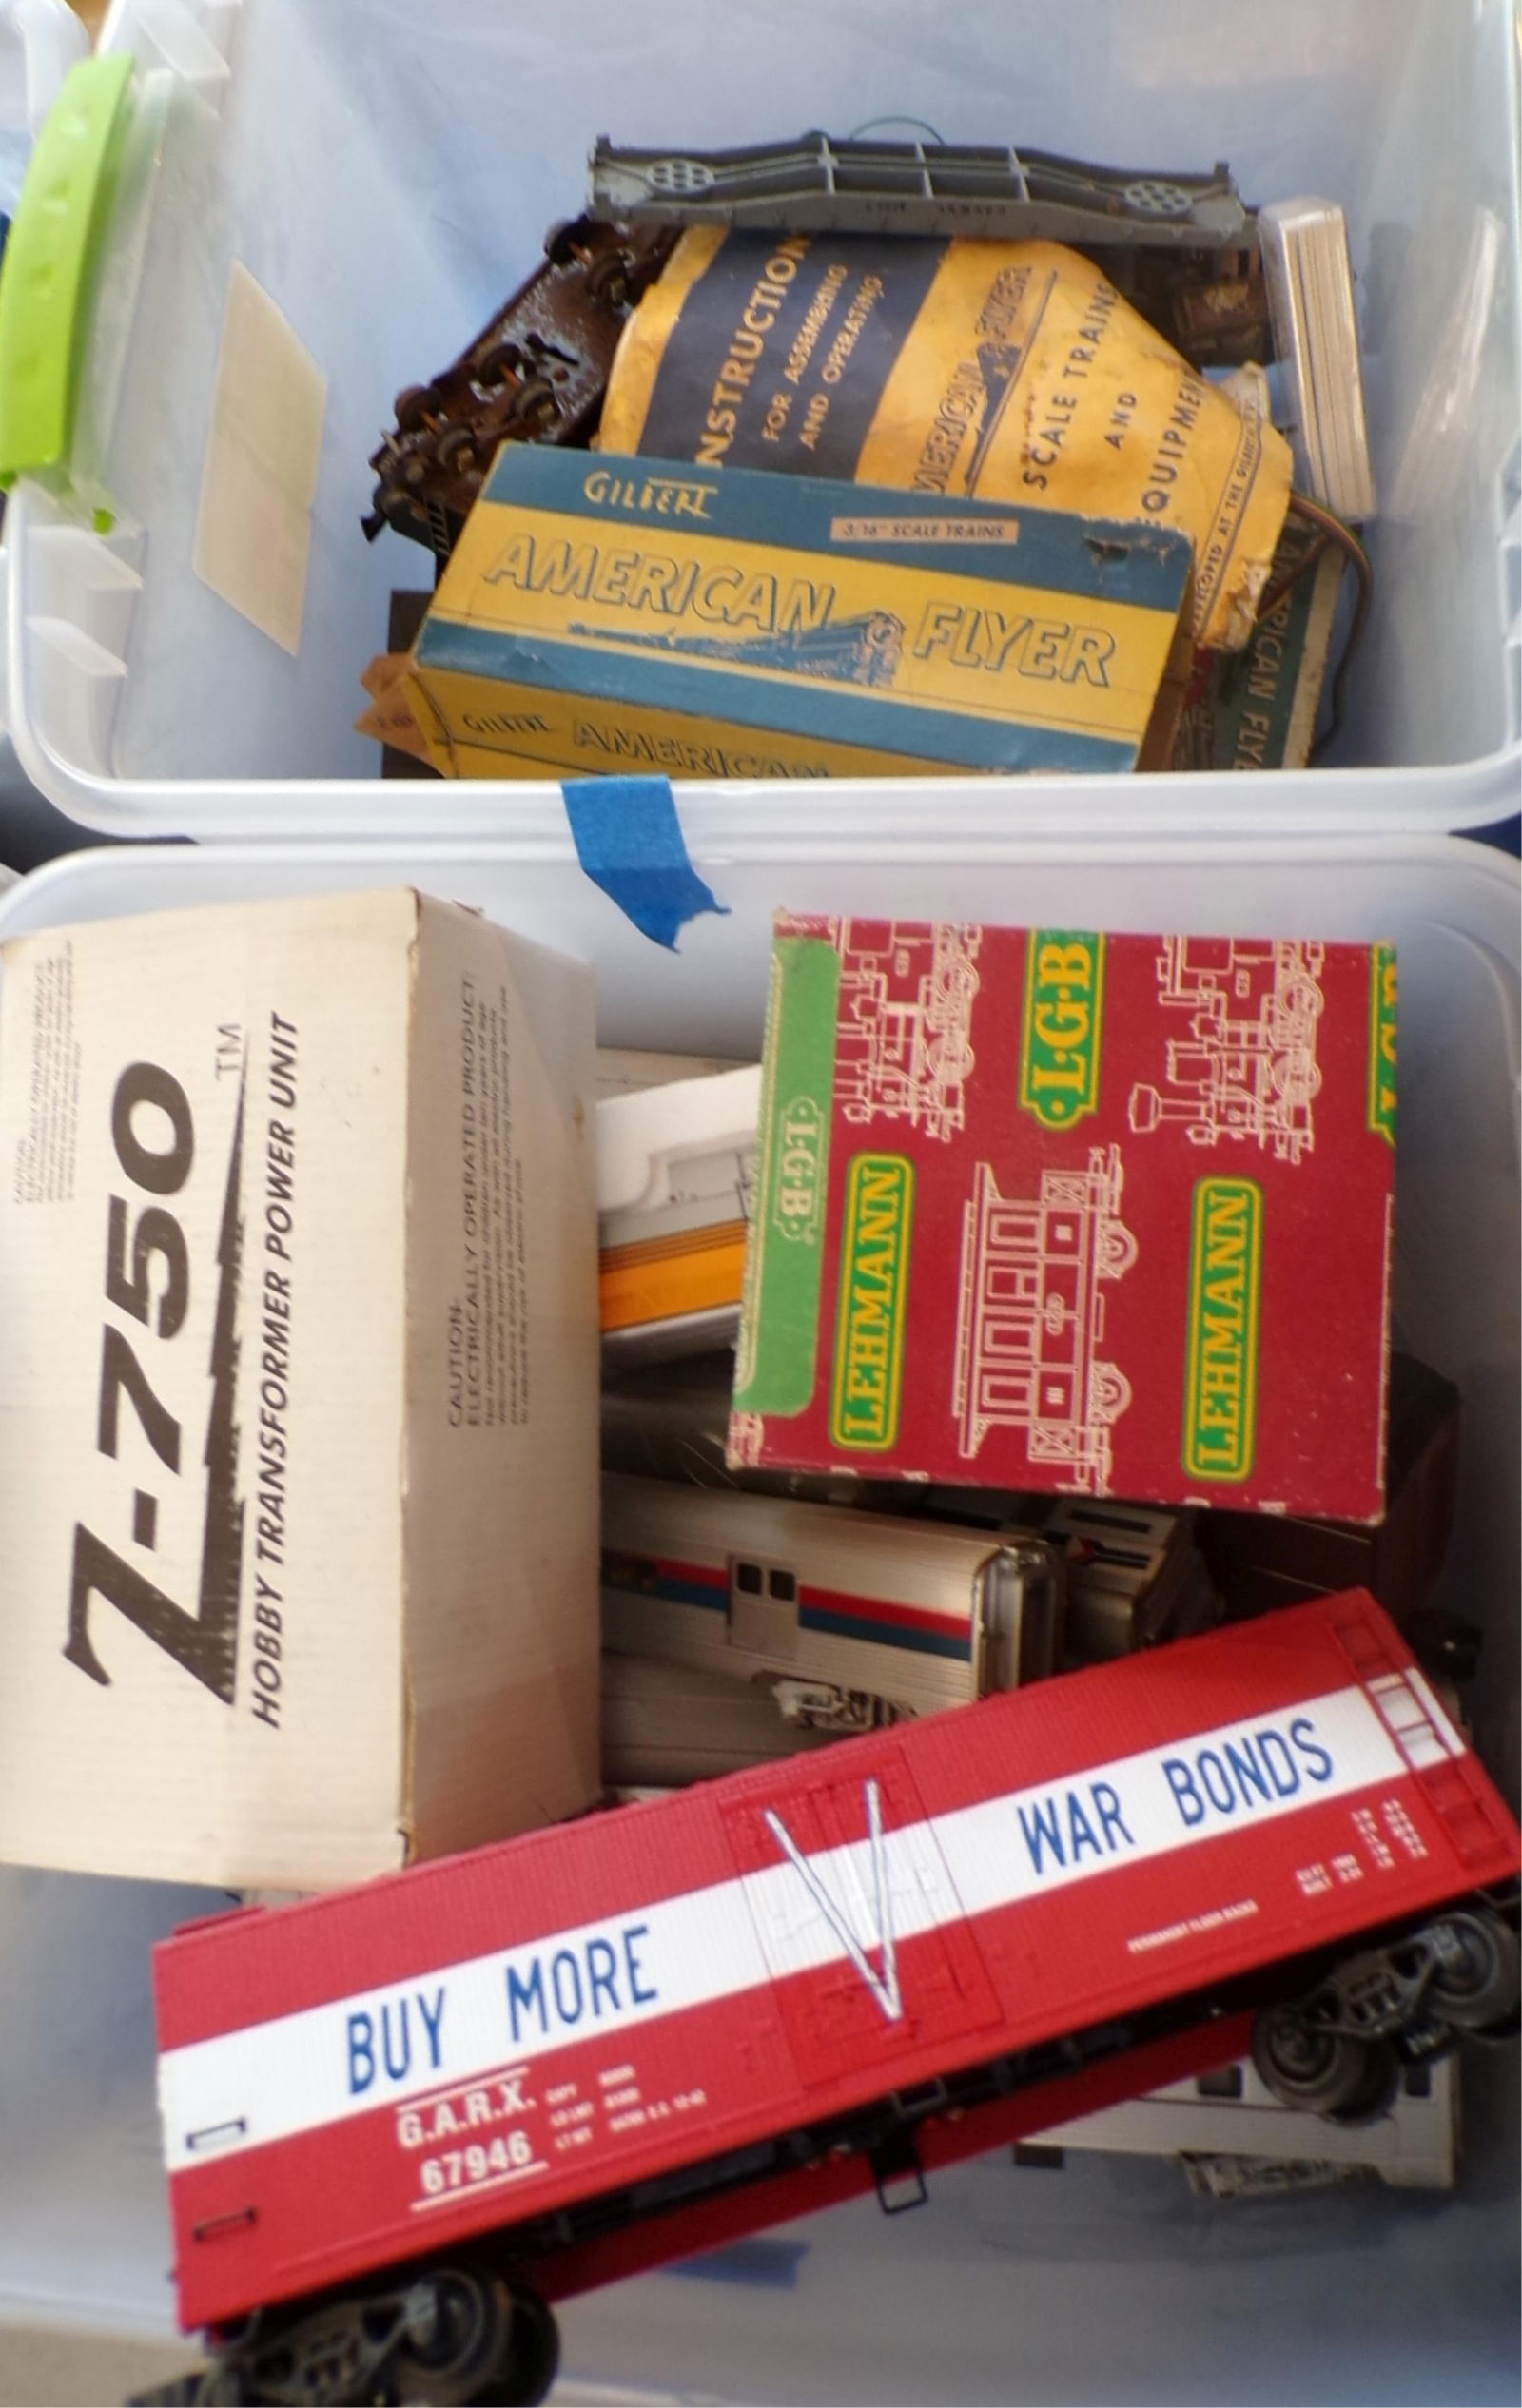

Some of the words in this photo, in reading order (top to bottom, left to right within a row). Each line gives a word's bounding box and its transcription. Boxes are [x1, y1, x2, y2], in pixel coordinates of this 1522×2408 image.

[761, 398, 793, 444] FOR
[784, 262, 848, 387] ASSEMBLING
[798, 393, 829, 450] AND
[822, 274, 884, 382] OPERATING
[973, 261, 1035, 343] FLYER
[1023, 387, 1079, 490] SCALE
[1104, 391, 1137, 449] AND
[583, 470, 720, 518] GILBERT
[891, 524, 940, 540] SCALE
[945, 524, 1006, 542] TRAINS
[1218, 517, 1228, 537] AT
[1224, 483, 1244, 511] THE
[483, 534, 838, 631] AMERICAN
[912, 602, 1119, 688] FLYER
[216, 1022, 243, 1083] TM
[268, 1009, 301, 1111] UNIT
[266, 1139, 296, 1262] POWER
[459, 1102, 478, 1238] OPERATED
[465, 1244, 480, 1426] ELECTRICALLY
[843, 1165, 902, 1438] LEHMANN
[1198, 1192, 1250, 1467] LEHMANN
[62, 1030, 244, 1705] Z-750
[255, 1275, 293, 1568] TRANSFORMER
[253, 1575, 284, 1730] HOBBY
[346, 1985, 447, 2095] BUY
[505, 1924, 658, 2043] MORE
[1017, 1780, 1137, 1875] WAR
[1161, 1718, 1334, 1827] BONDS
[396, 2077, 537, 2149] G.A.R.X.
[420, 2131, 533, 2194] 67946
